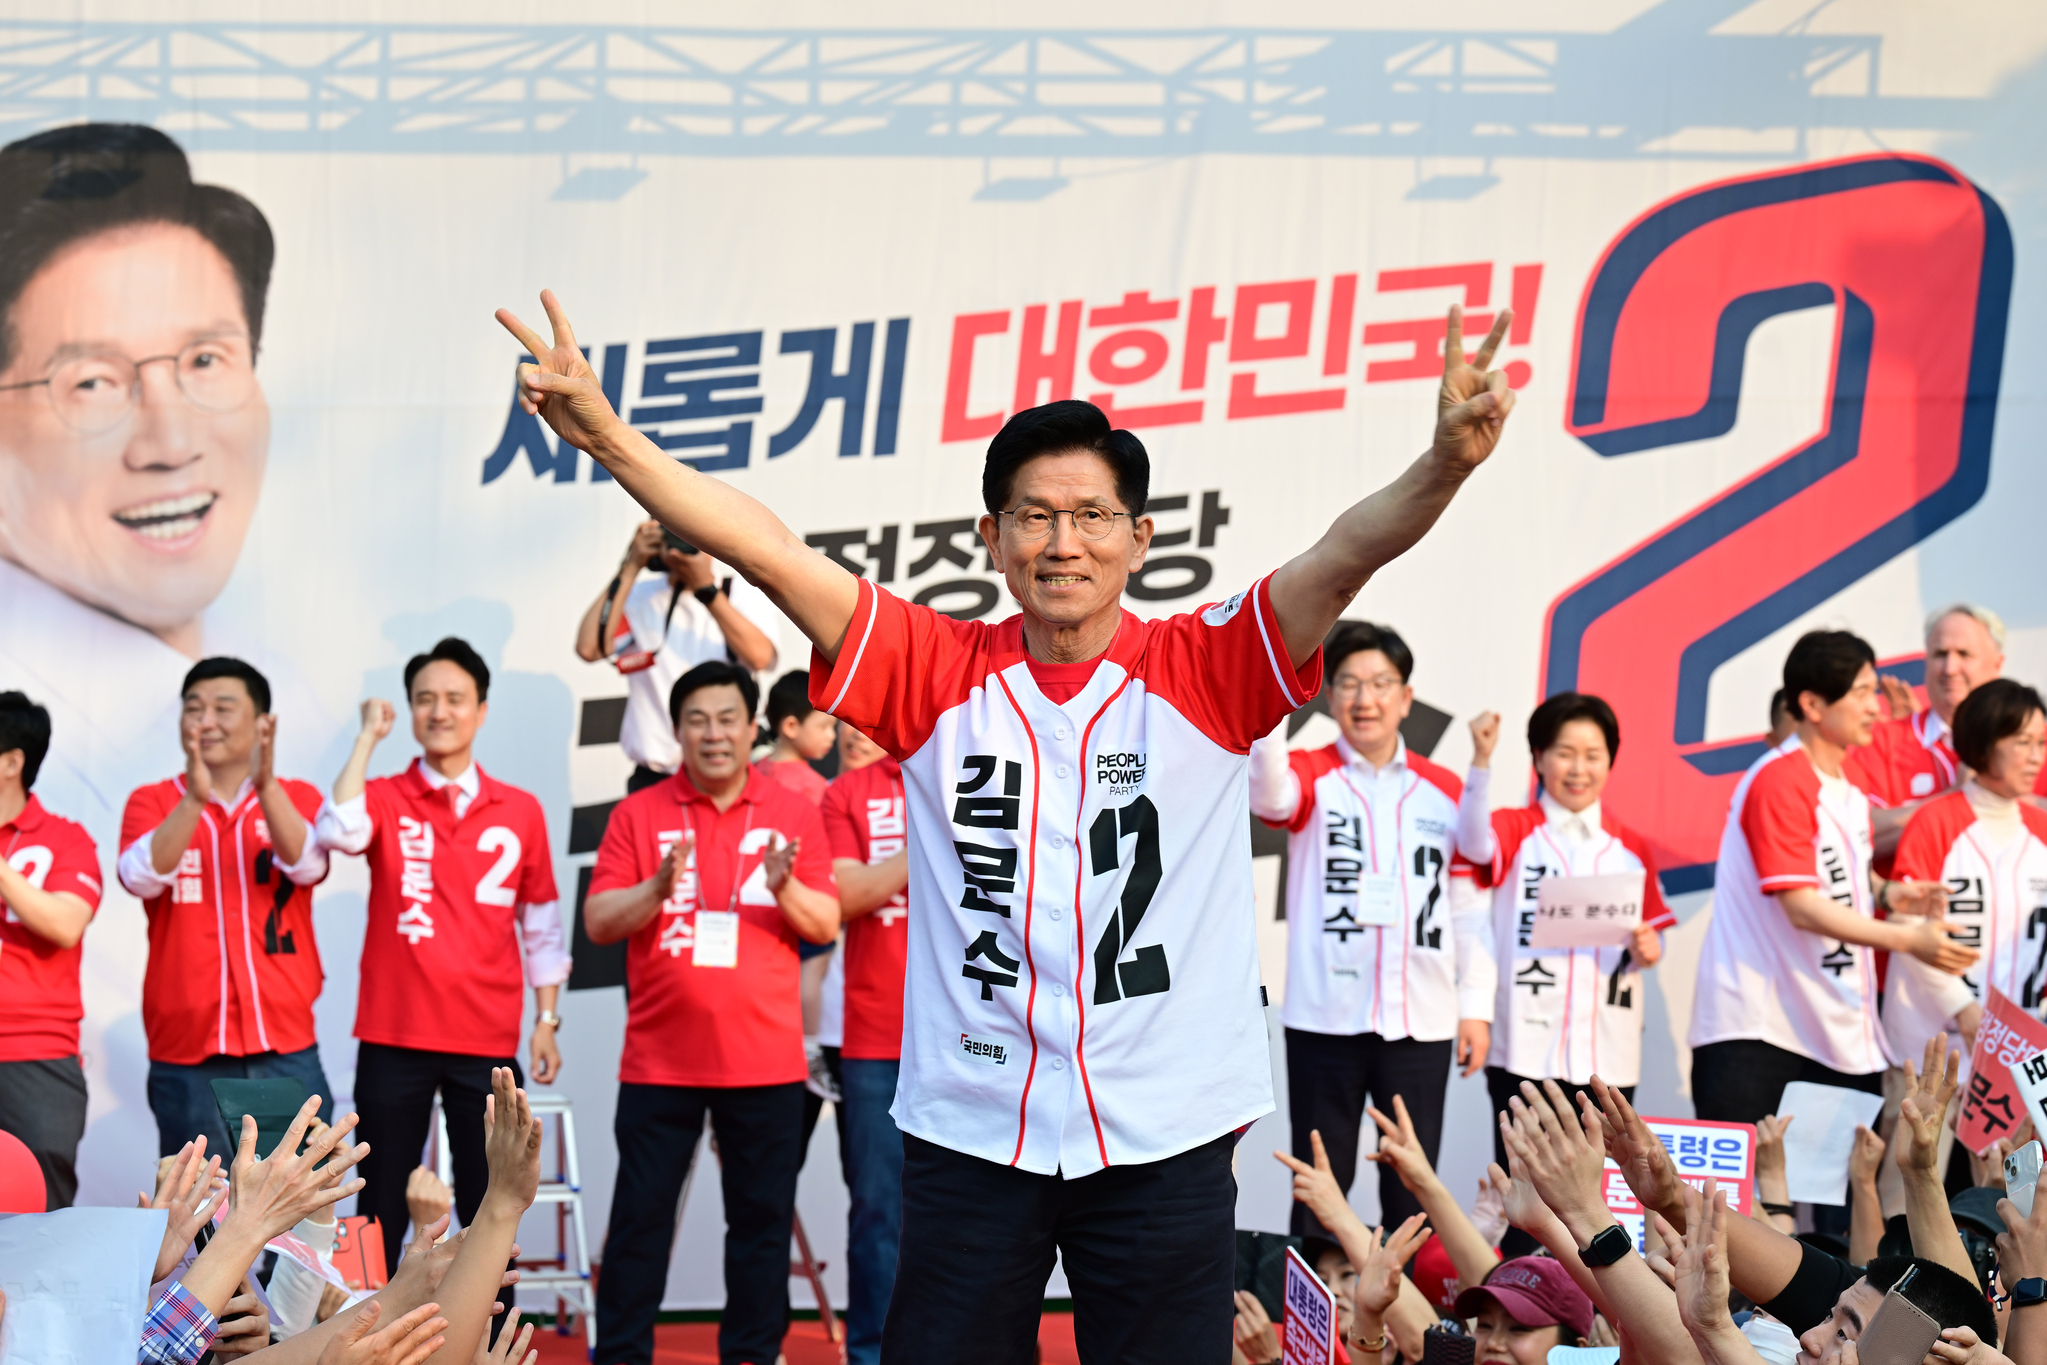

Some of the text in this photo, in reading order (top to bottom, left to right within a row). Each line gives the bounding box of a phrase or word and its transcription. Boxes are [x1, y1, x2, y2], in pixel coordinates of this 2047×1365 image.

[940, 261, 1544, 444] 대한민국!
[1533, 150, 2015, 895] 2
[1097, 753, 1146, 768] PEOPL
[1109, 783, 1140, 796] PARTY
[255, 848, 297, 955] 2
[397, 815, 435, 945] 김문수
[475, 825, 522, 908] 2
[738, 827, 788, 907] 2
[953, 755, 1022, 1001] 김문수
[1089, 794, 1171, 1006] 2
[1323, 811, 1364, 942] 김문수
[1414, 845, 1444, 951] 2
[963, 1039, 1004, 1059] 국민의힘
[1288, 1268, 1328, 1343] 대통령은
